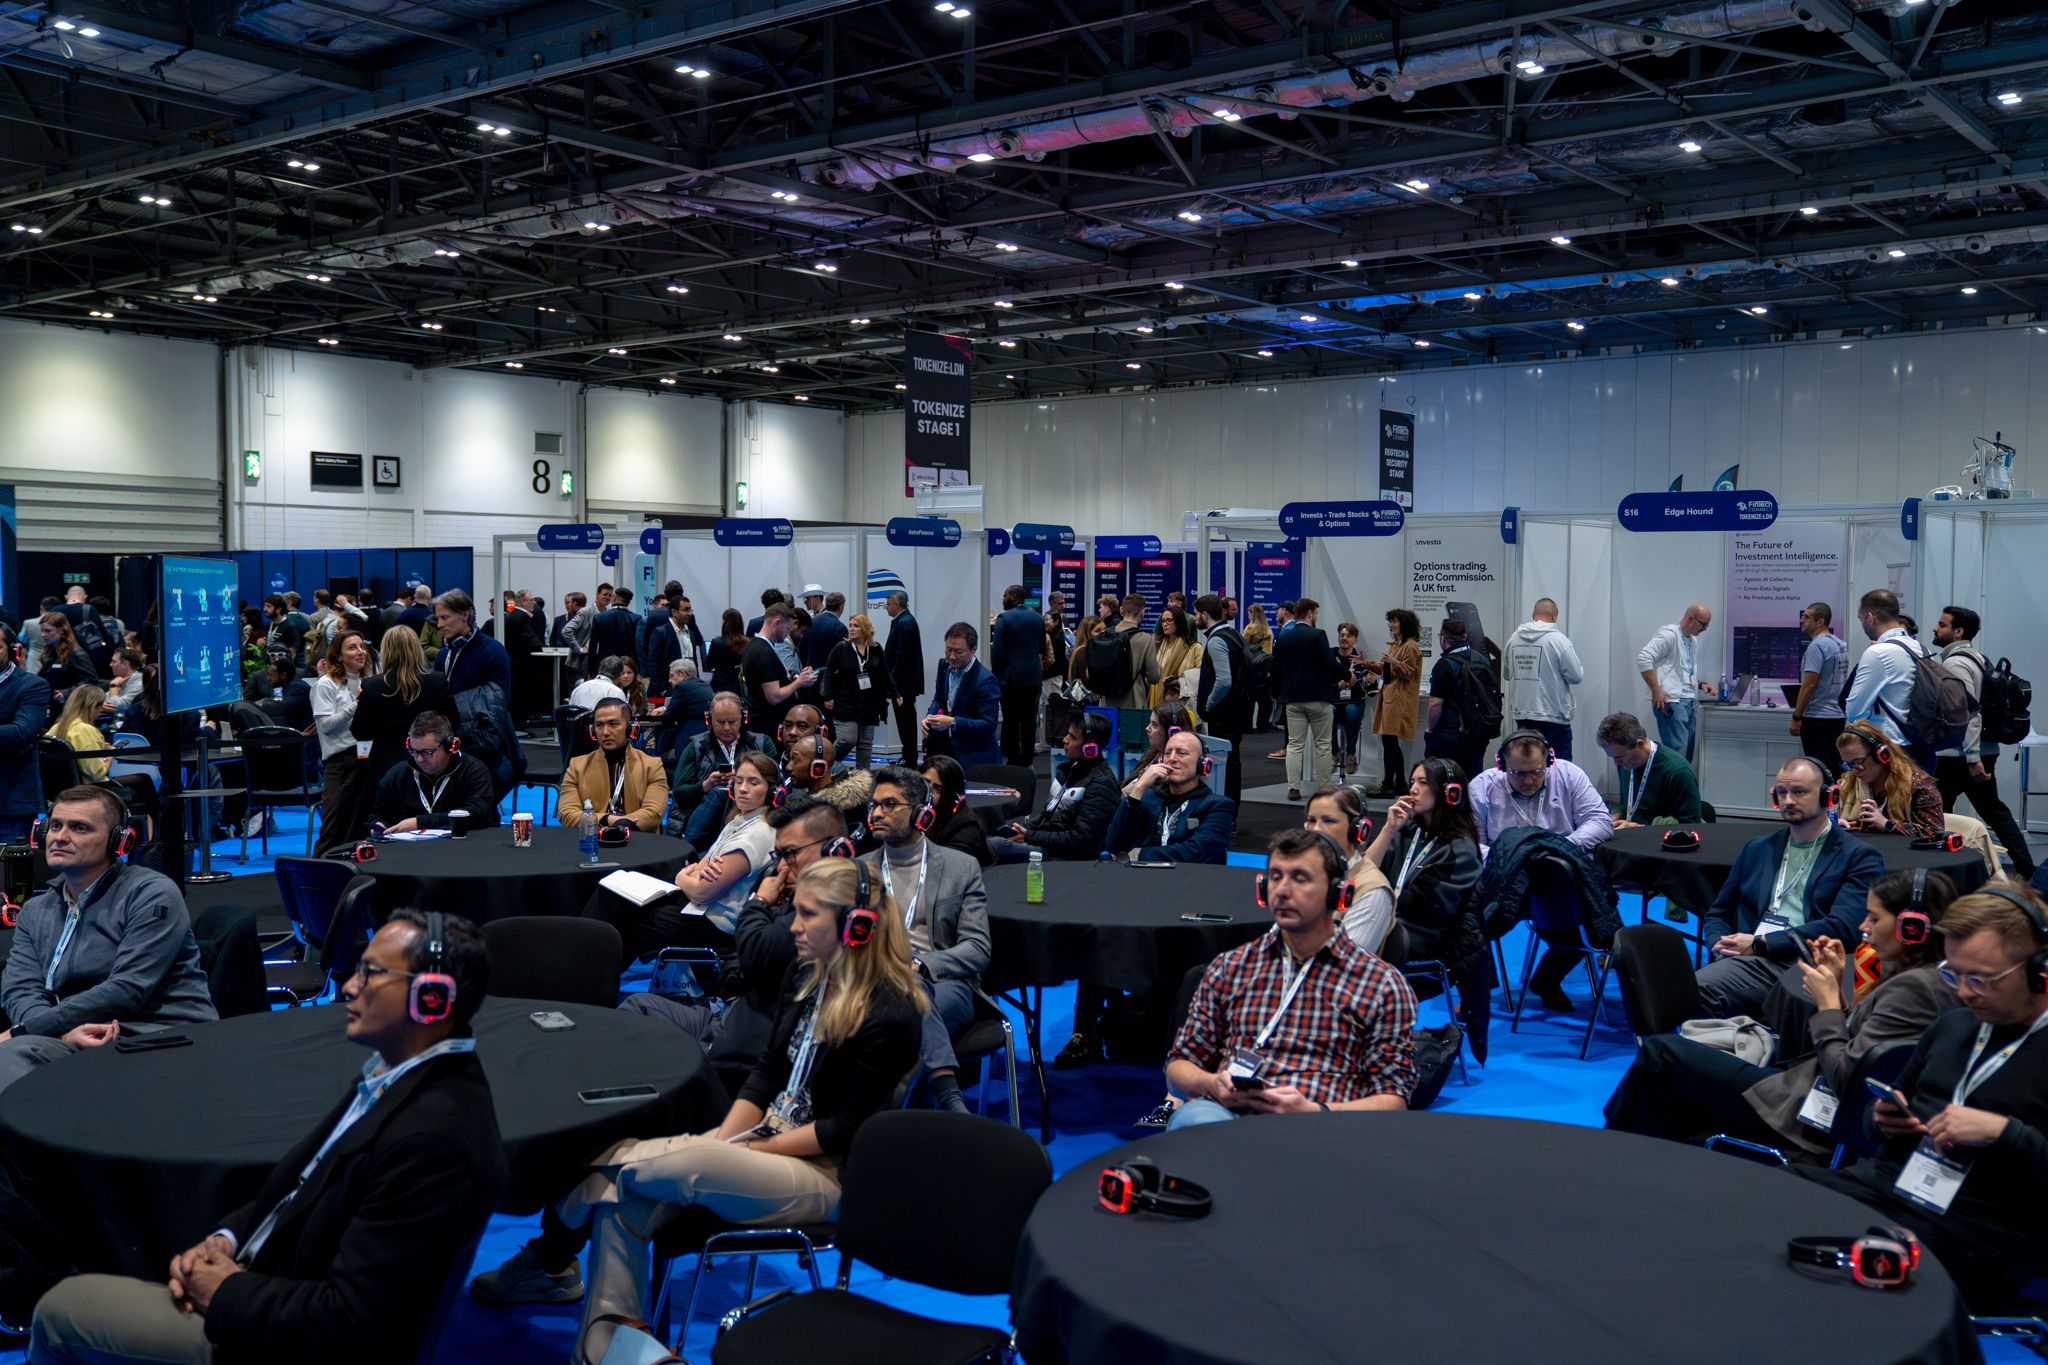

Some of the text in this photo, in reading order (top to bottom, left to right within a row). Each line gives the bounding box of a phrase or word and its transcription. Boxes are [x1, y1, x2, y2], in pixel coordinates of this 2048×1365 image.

[913, 356, 964, 376] TOKENIZE:LDN
[912, 399, 965, 418] TOKENIZE
[918, 419, 953, 436] STAGE
[1386, 459, 1408, 468] SECURITY
[532, 459, 551, 494] 8
[1389, 469, 1404, 478] STAGE
[1624, 507, 1713, 517] S16 Edge Hound
[1325, 520, 1350, 528] Options
[1735, 540, 1794, 549] The Future of
[1735, 552, 1838, 562] Investment Intelligence.
[1413, 562, 1488, 572] Options trading.
[1413, 573, 1495, 581] Zero Commission.
[1413, 583, 1457, 592] A UK first.
